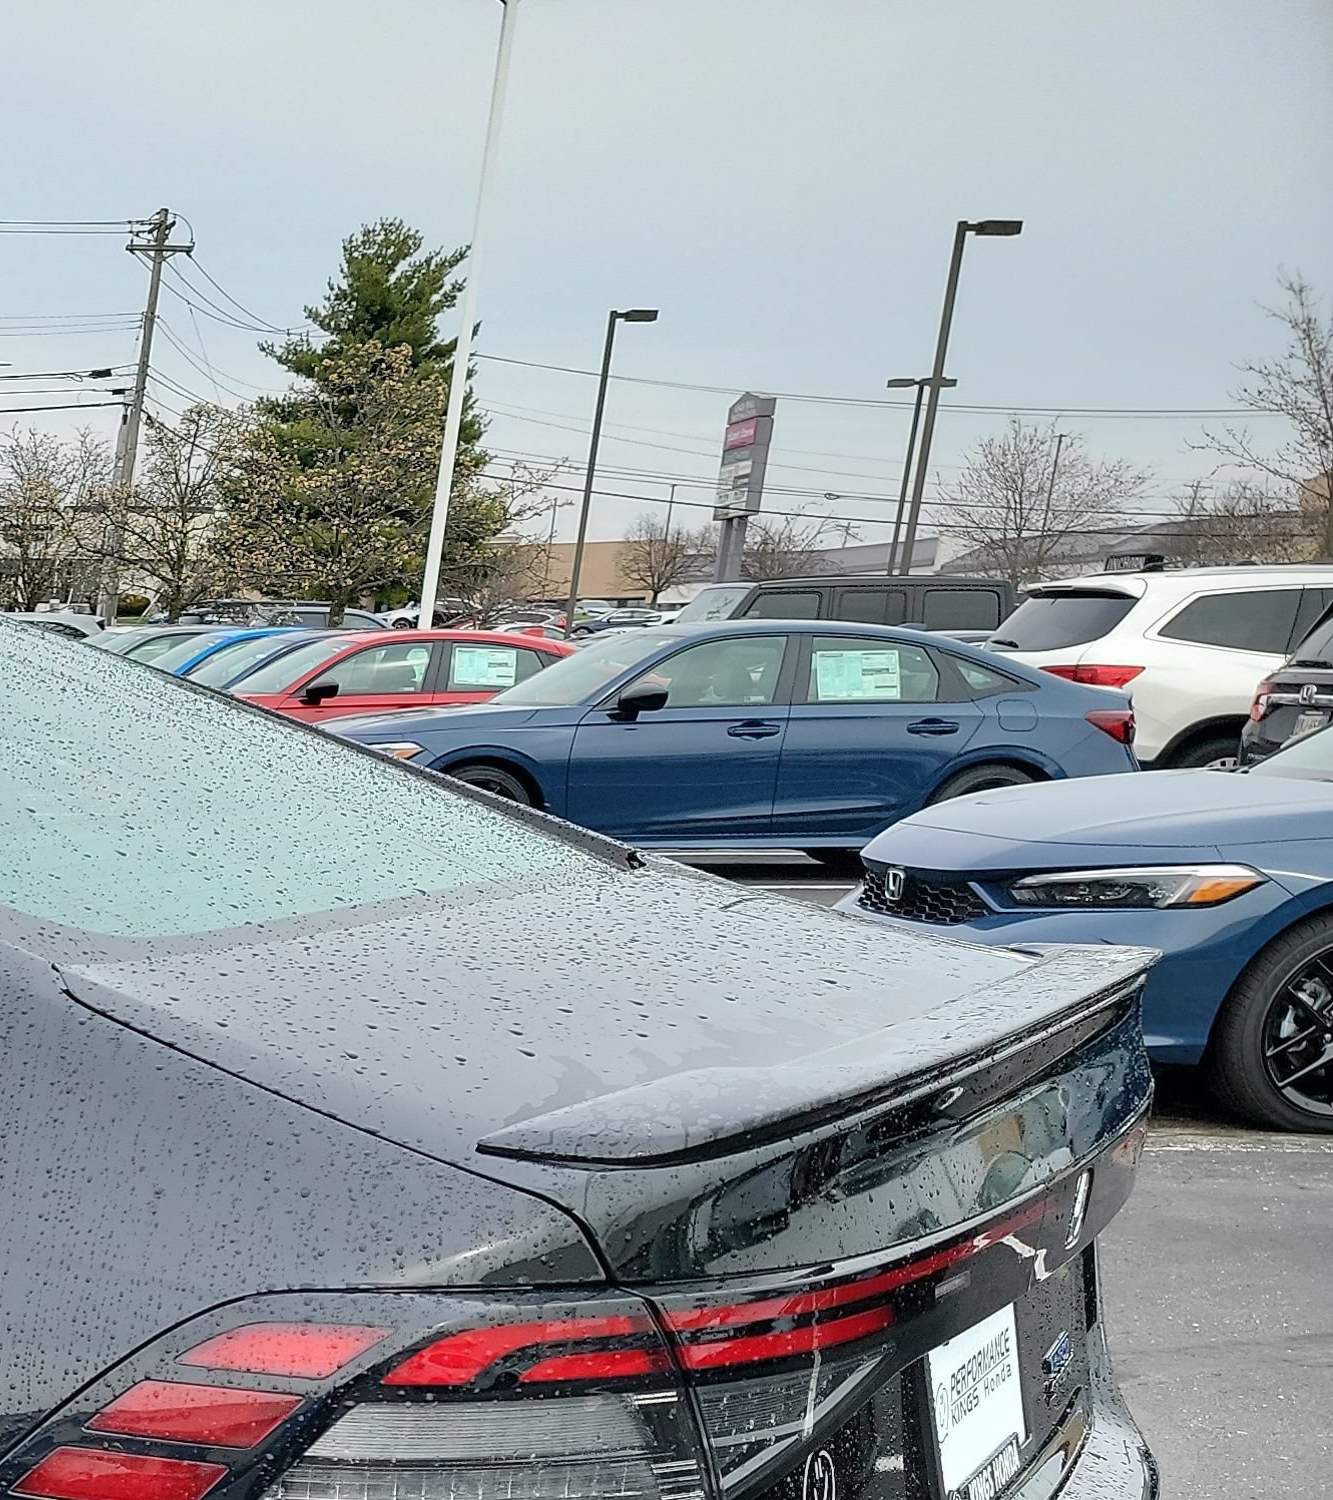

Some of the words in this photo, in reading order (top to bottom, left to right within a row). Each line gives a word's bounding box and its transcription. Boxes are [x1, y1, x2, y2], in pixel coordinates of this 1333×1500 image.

[949, 1327, 1011, 1397] PERFORMANCE
[950, 1387, 980, 1428] KINGS
[983, 1363, 1012, 1400] Honda
[992, 1439, 1021, 1495] HONDA
